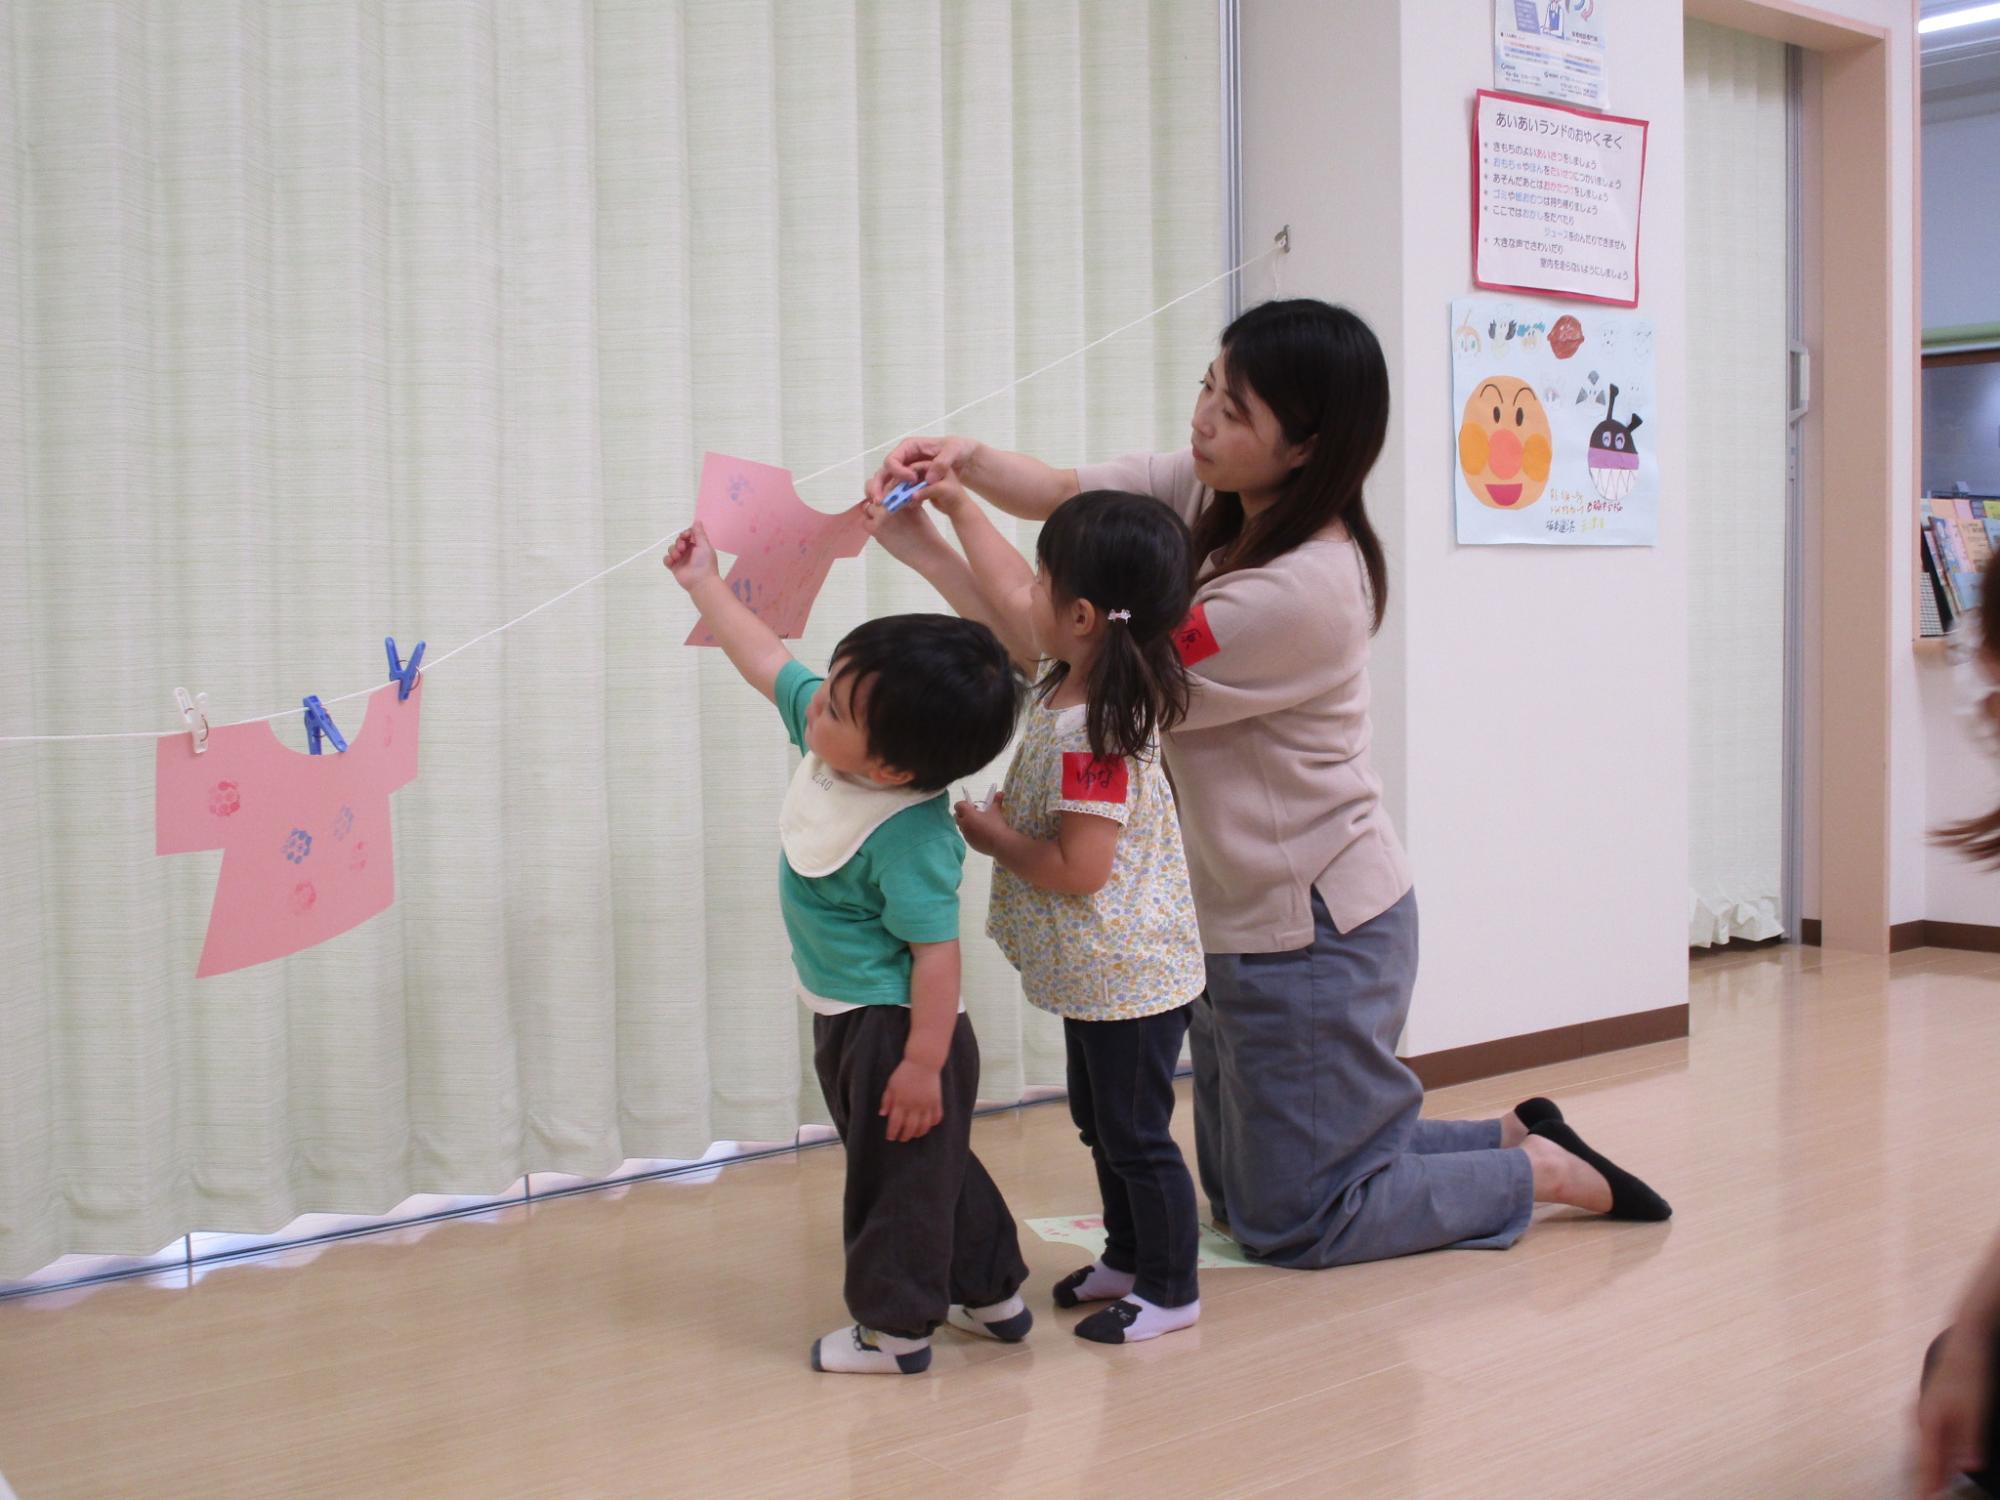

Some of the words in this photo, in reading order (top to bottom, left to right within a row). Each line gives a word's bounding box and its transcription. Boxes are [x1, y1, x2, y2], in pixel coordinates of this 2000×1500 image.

[1496, 112, 1624, 149] あいあいランドのおやくそく
